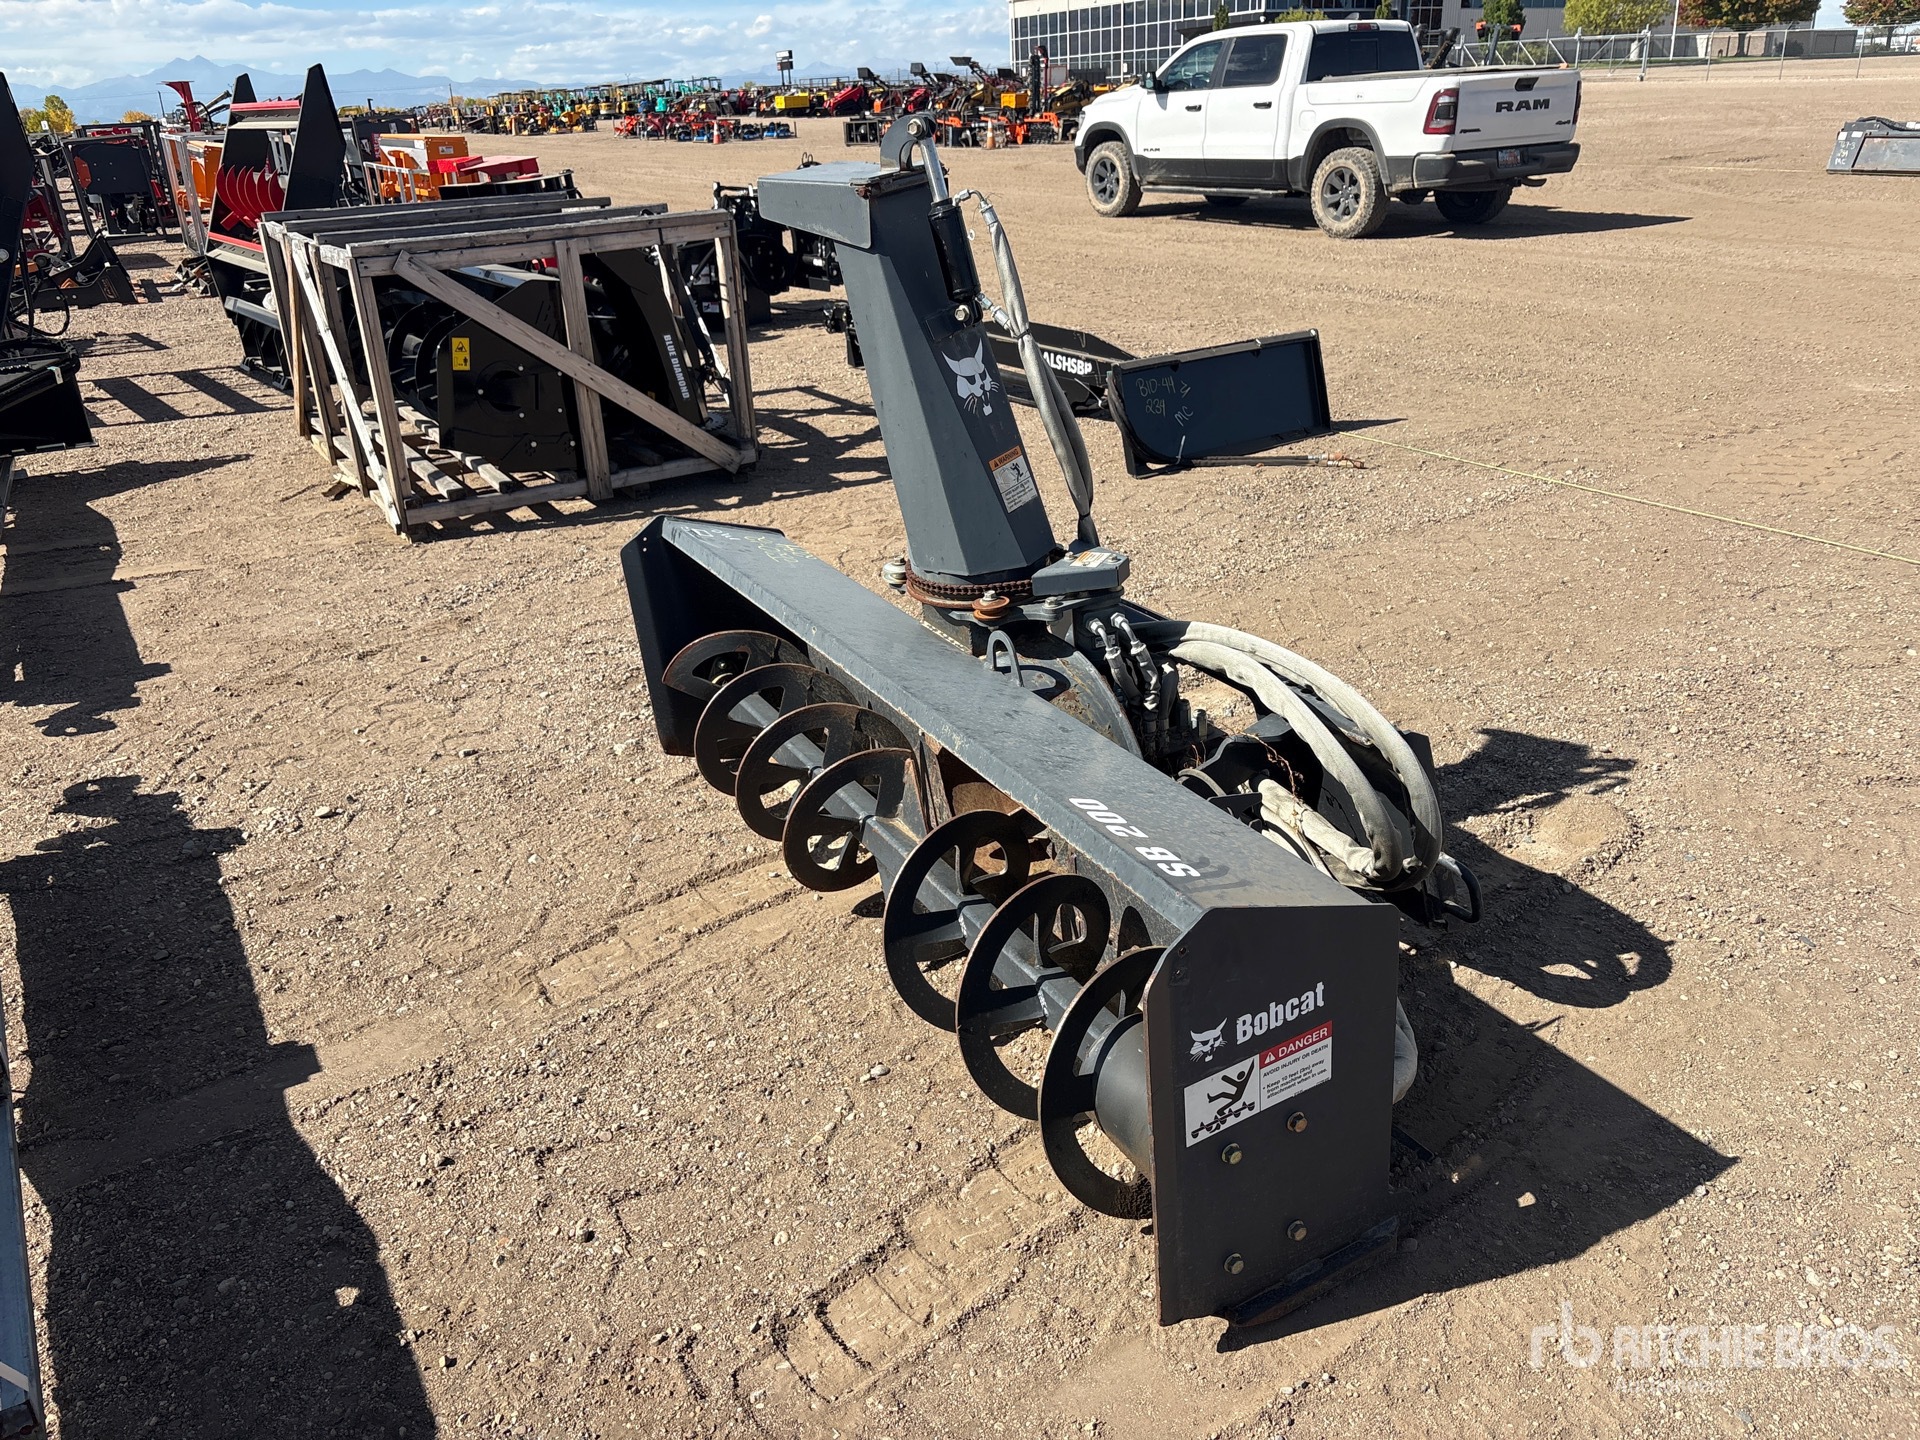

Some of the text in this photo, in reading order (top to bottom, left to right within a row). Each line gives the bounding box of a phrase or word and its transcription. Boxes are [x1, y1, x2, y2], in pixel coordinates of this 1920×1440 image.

[1495, 98, 1551, 113] RAM
[663, 334, 690, 399] BLUE DIAMOND
[1145, 398, 1166, 417] 234
[1174, 405, 1194, 427] MC
[1068, 797, 1201, 877] SB 200
[1236, 981, 1325, 1045] Bobcat
[1278, 1027, 1327, 1058] DANGER
[1263, 1043, 1328, 1078] AVOID INJURY OR DEATH
[1266, 1079, 1280, 1089] Keep
[1288, 1070, 1298, 1079] feet
[1311, 1059, 1324, 1069] away
[1266, 1068, 1312, 1094] from machine and
[1266, 1081, 1296, 1099] attachment
[1296, 1075, 1311, 1086] when
